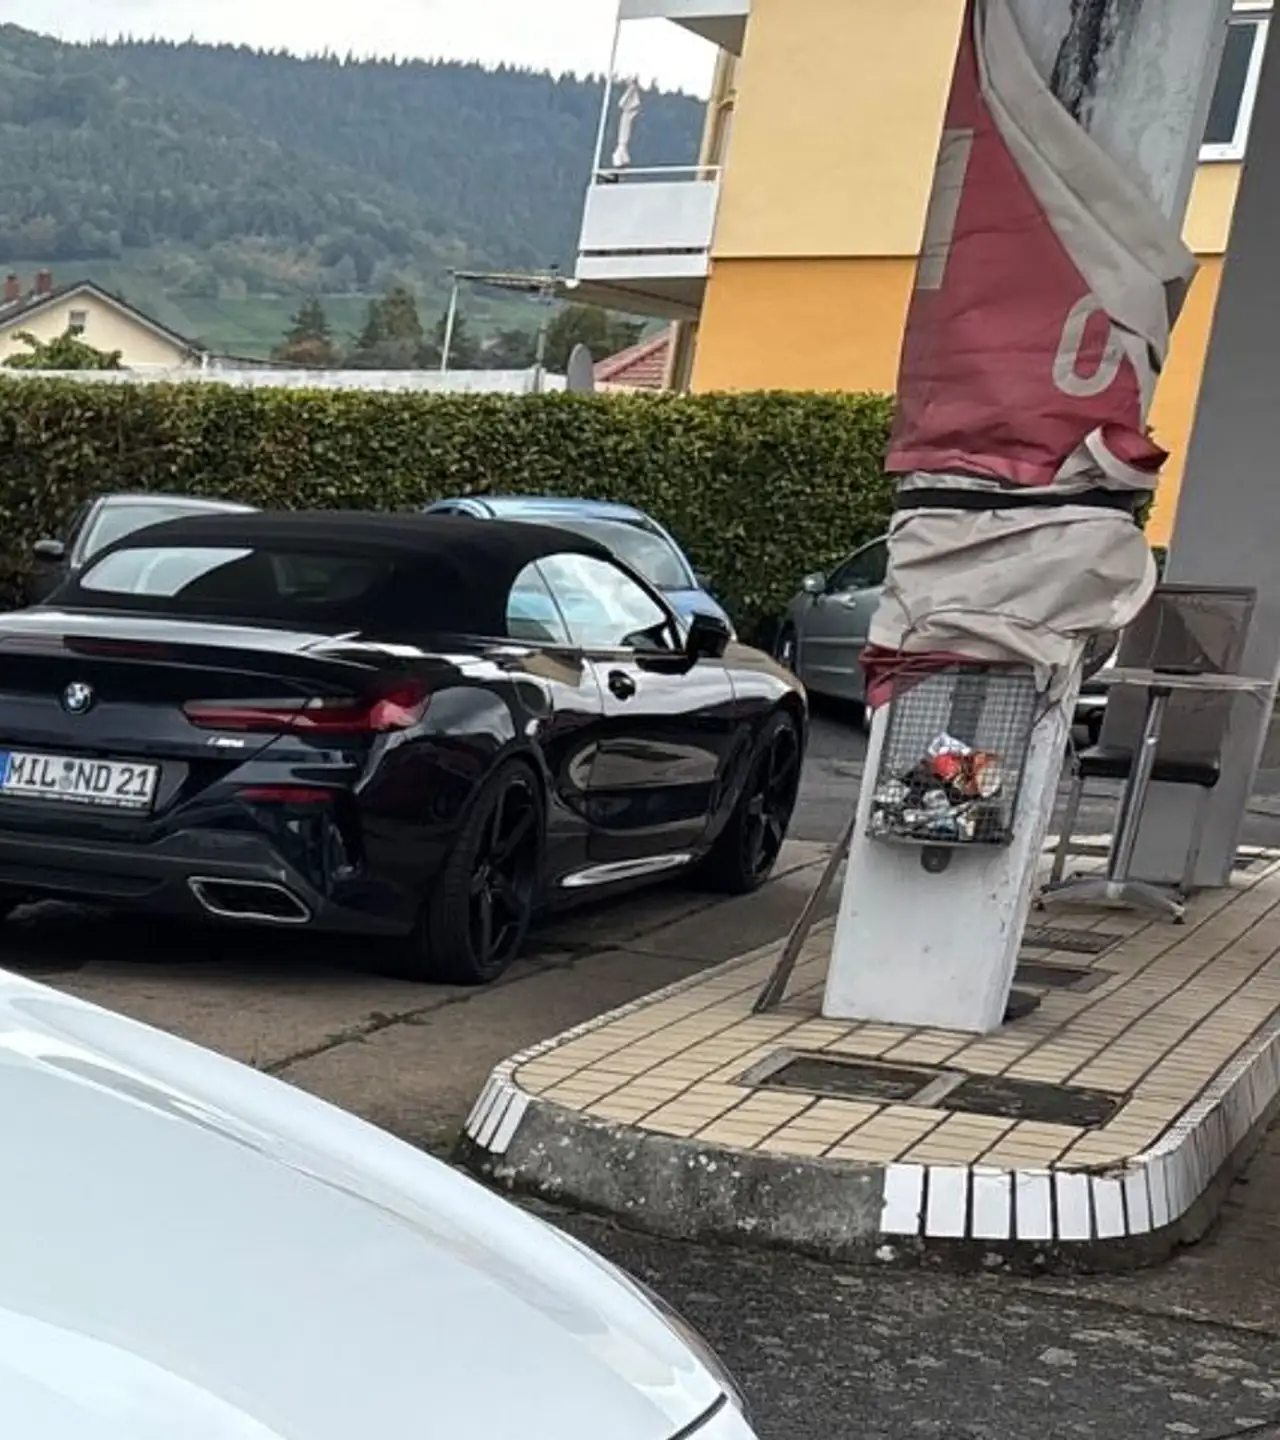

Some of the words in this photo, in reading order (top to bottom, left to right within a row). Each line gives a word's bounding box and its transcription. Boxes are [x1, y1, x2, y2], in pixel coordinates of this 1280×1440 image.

[5, 756, 58, 789] MIL
[73, 761, 112, 793] ND
[114, 768, 150, 797] 21
